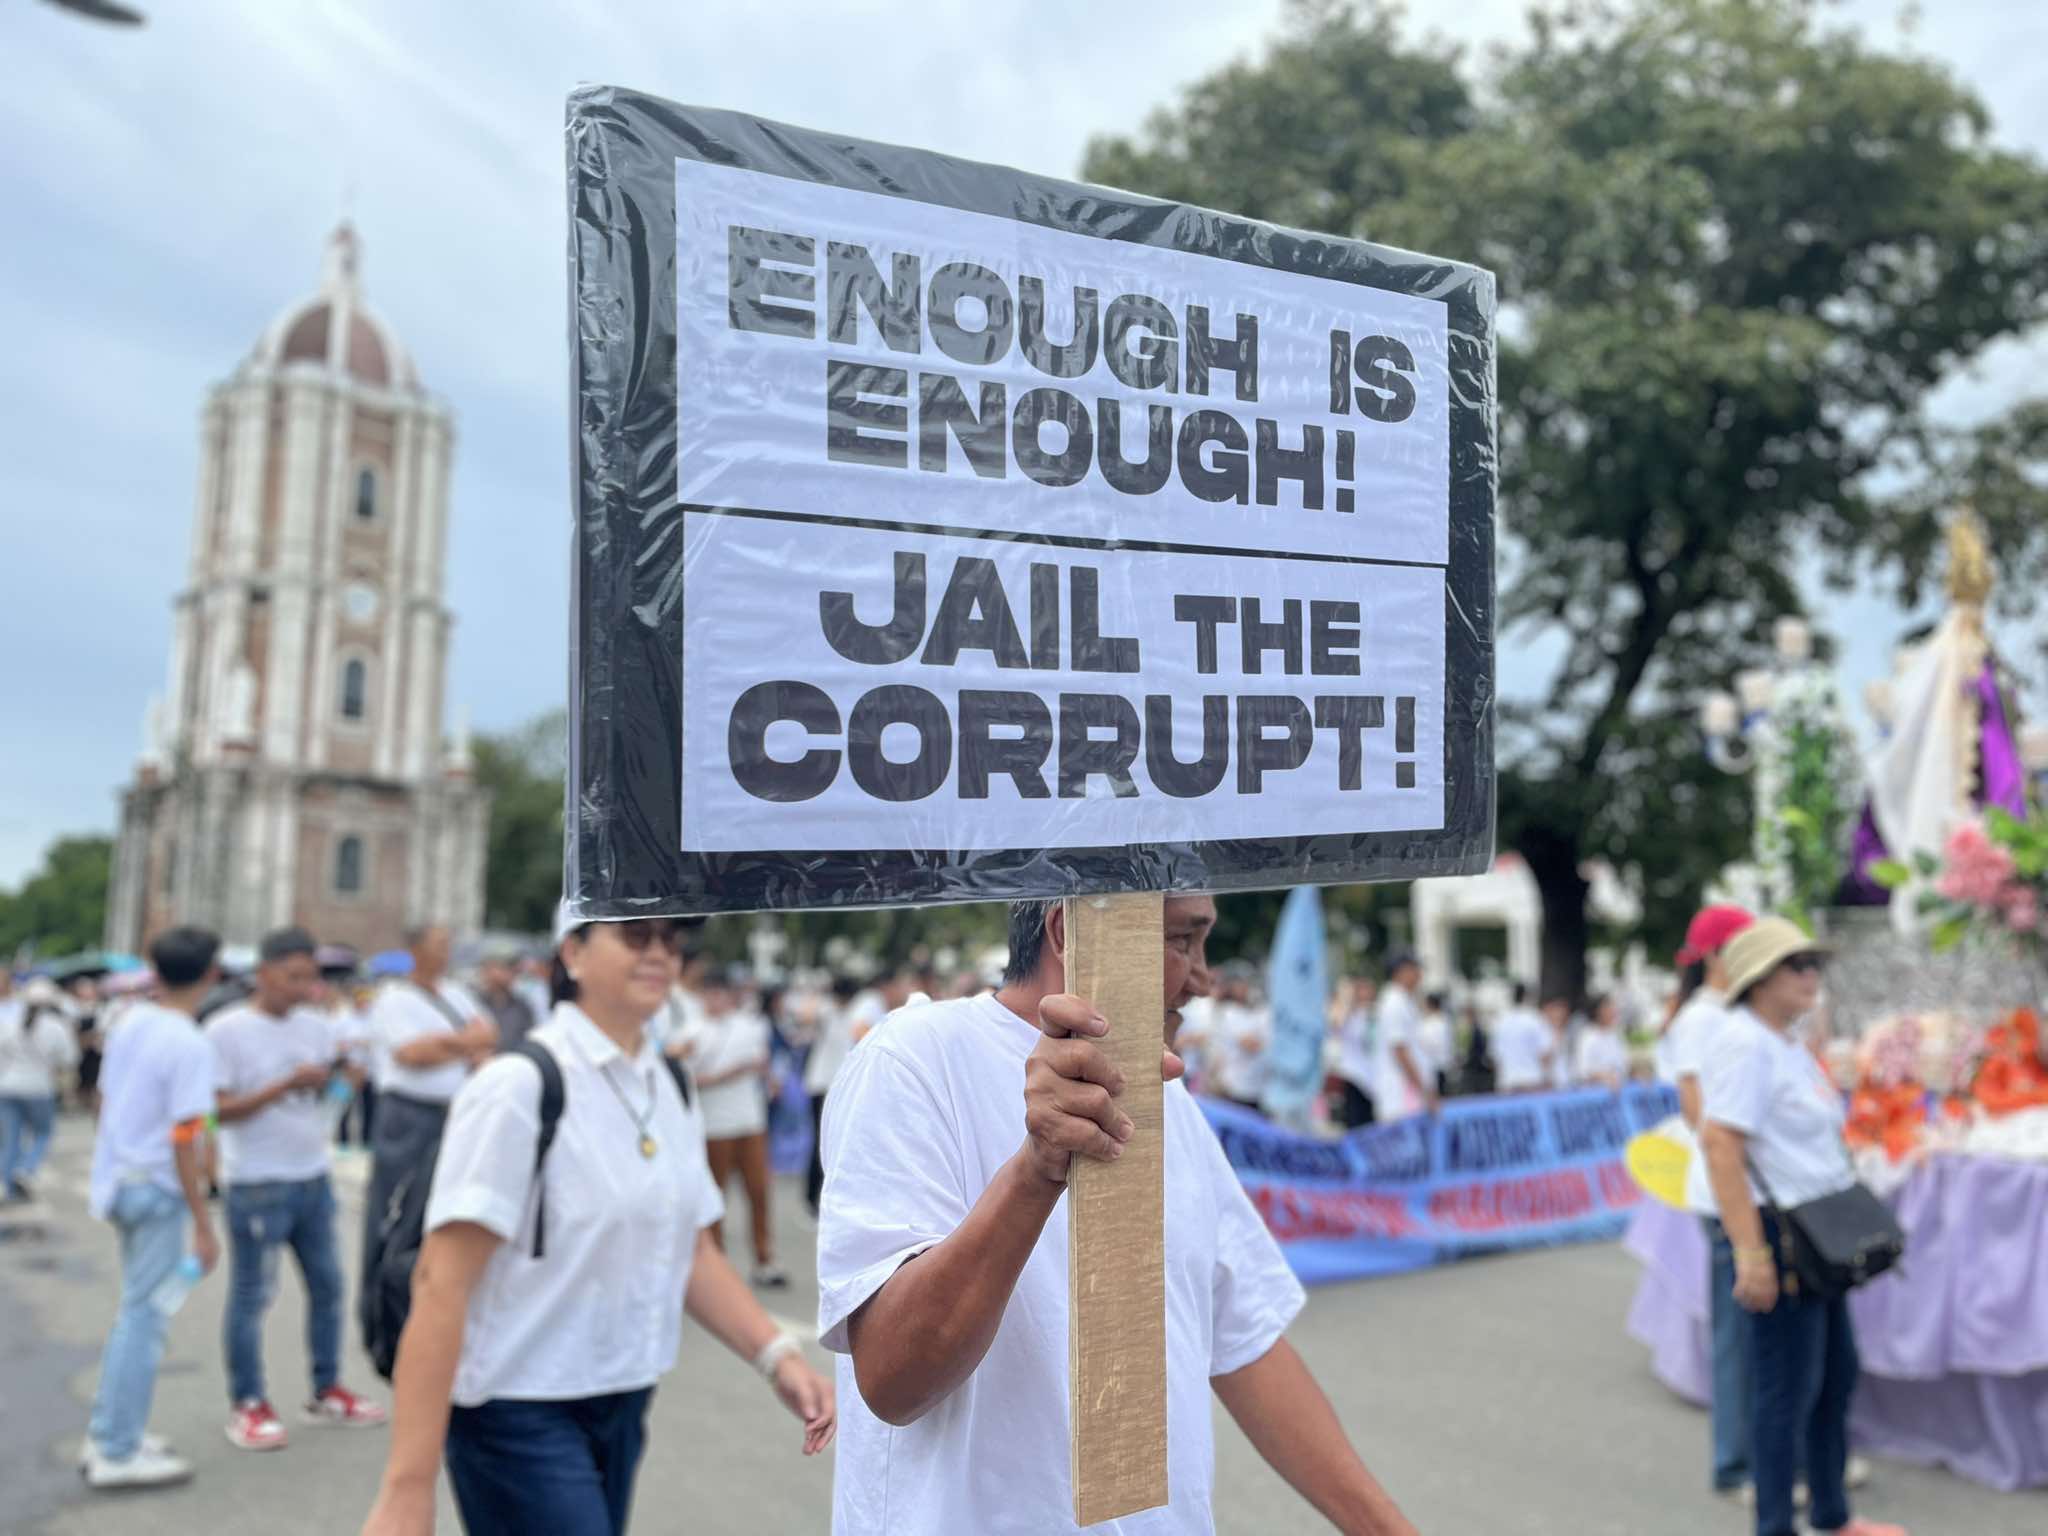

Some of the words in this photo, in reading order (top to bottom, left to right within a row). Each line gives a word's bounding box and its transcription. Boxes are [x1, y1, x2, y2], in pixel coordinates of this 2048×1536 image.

[728, 224, 1259, 402] ENOUGH
[1329, 328, 1417, 423] IS
[827, 359, 1356, 513] ENOUGH!
[819, 551, 1141, 673] JAIL
[1174, 594, 1361, 676] THE
[728, 680, 1416, 802] CORRUPT!
